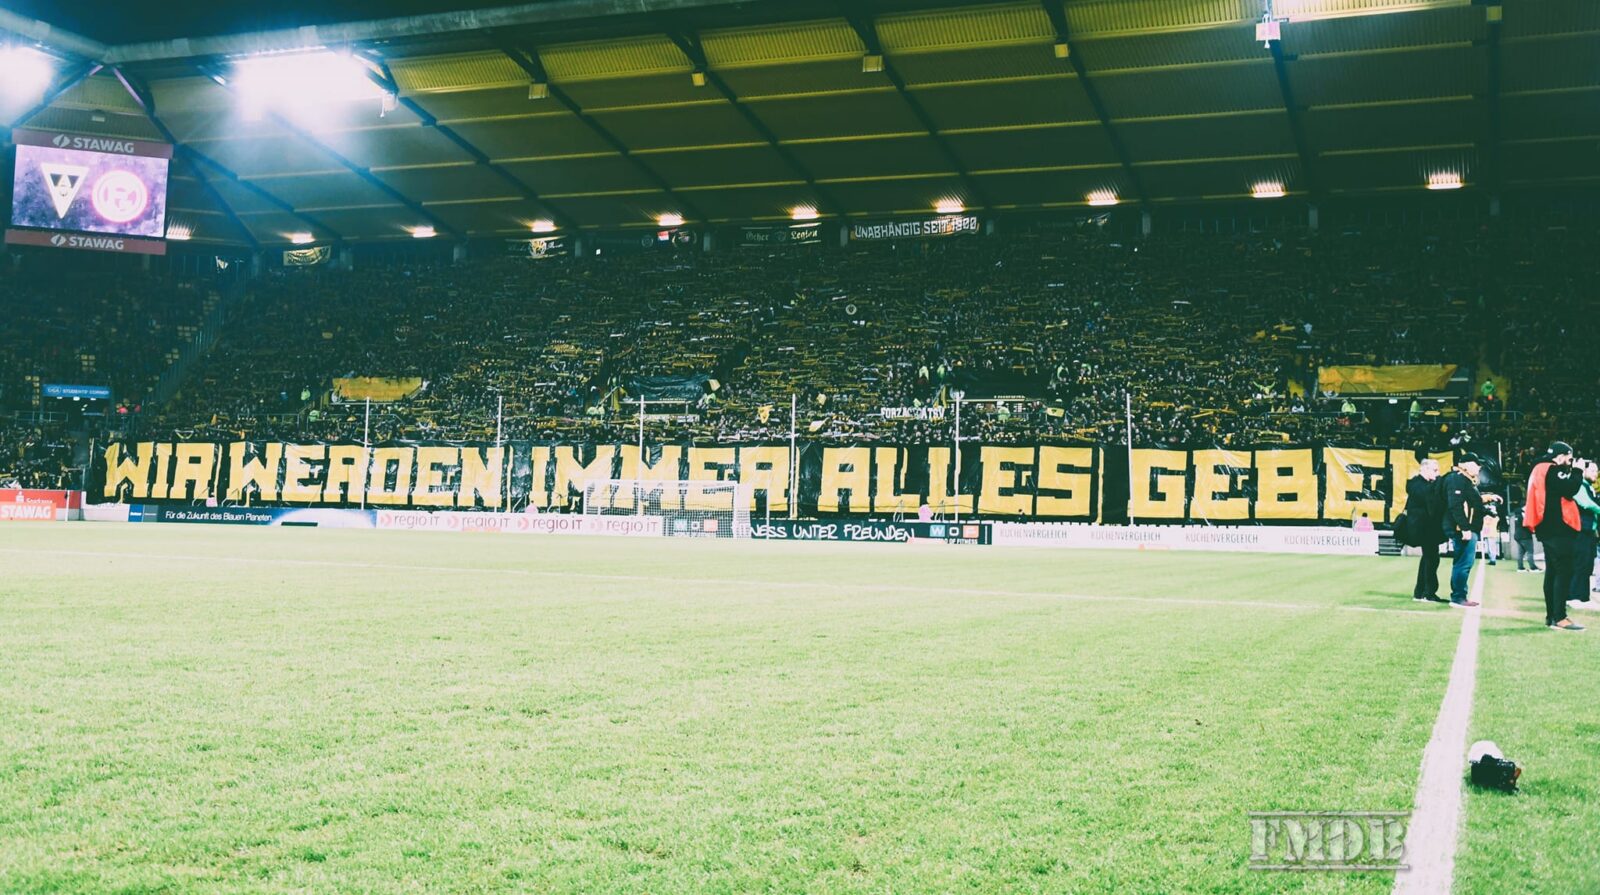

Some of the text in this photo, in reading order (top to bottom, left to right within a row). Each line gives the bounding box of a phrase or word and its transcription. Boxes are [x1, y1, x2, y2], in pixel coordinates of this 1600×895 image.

[73, 137, 135, 153] STAWAG
[855, 222, 920, 238] UNABHÄNGIG
[923, 218, 949, 234] SEIT
[69, 236, 124, 250] STAWAG
[104, 441, 215, 499] WIR
[226, 441, 504, 507] WERDEN
[529, 444, 790, 512] IMMER
[817, 446, 1093, 516] ALLES
[165, 510, 175, 519] Für
[176, 511, 186, 520] die
[186, 511, 209, 520] Zukunft
[210, 512, 222, 520] des
[223, 512, 245, 521] Blauen
[245, 513, 272, 522] Planeten
[394, 514, 427, 528] regio
[532, 517, 569, 533] regio
[606, 519, 643, 535] regio
[792, 523, 838, 540] UNTER
[843, 523, 915, 541] FREUNDEN
